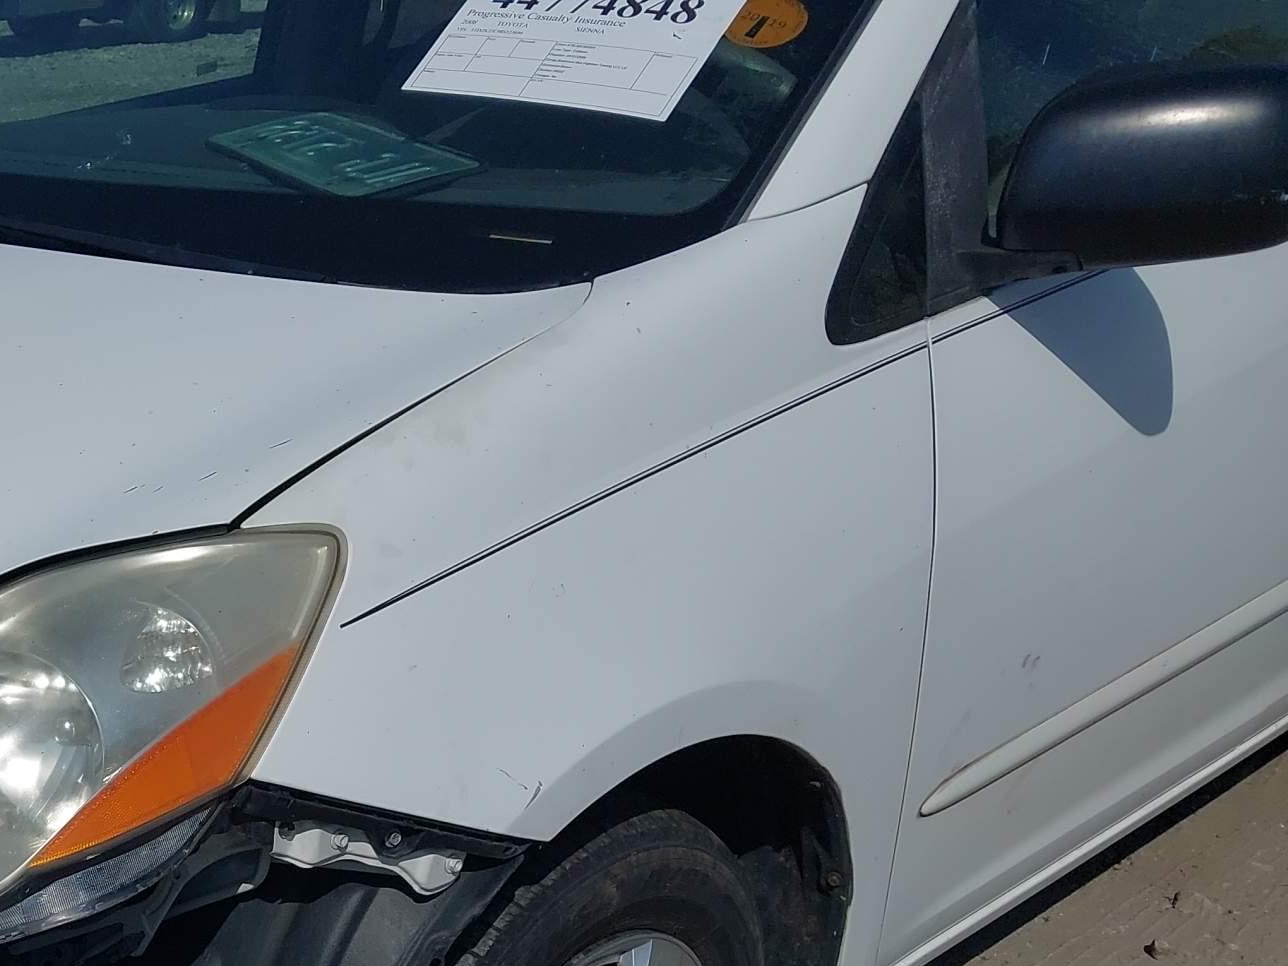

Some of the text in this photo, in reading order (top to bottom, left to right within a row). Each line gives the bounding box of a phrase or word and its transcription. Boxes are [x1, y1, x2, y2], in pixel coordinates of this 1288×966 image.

[467, 9, 626, 27] Progressive Casualty Insurance
[576, 26, 605, 34] SIENNA
